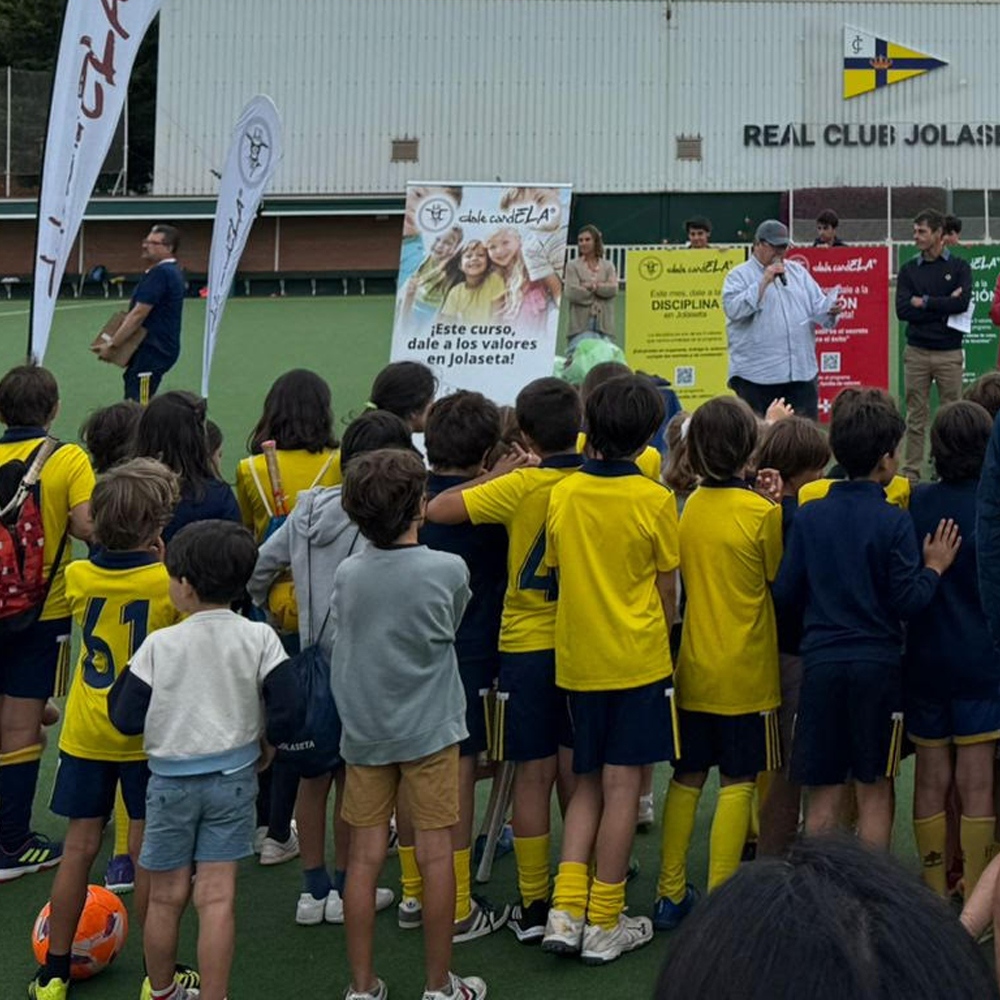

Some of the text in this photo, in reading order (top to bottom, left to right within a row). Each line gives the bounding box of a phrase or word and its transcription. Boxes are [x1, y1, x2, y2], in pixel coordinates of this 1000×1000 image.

[743, 124, 815, 146] REAL
[823, 124, 895, 146] CLUB
[459, 209, 488, 224] dale
[651, 299, 720, 311] DISCIPLINA
[430, 323, 516, 337] ¡Este curso,
[407, 337, 538, 350] dale a los valores
[427, 352, 515, 368] en Jolaseta!
[516, 520, 560, 603] 4
[81, 596, 150, 690] 61
